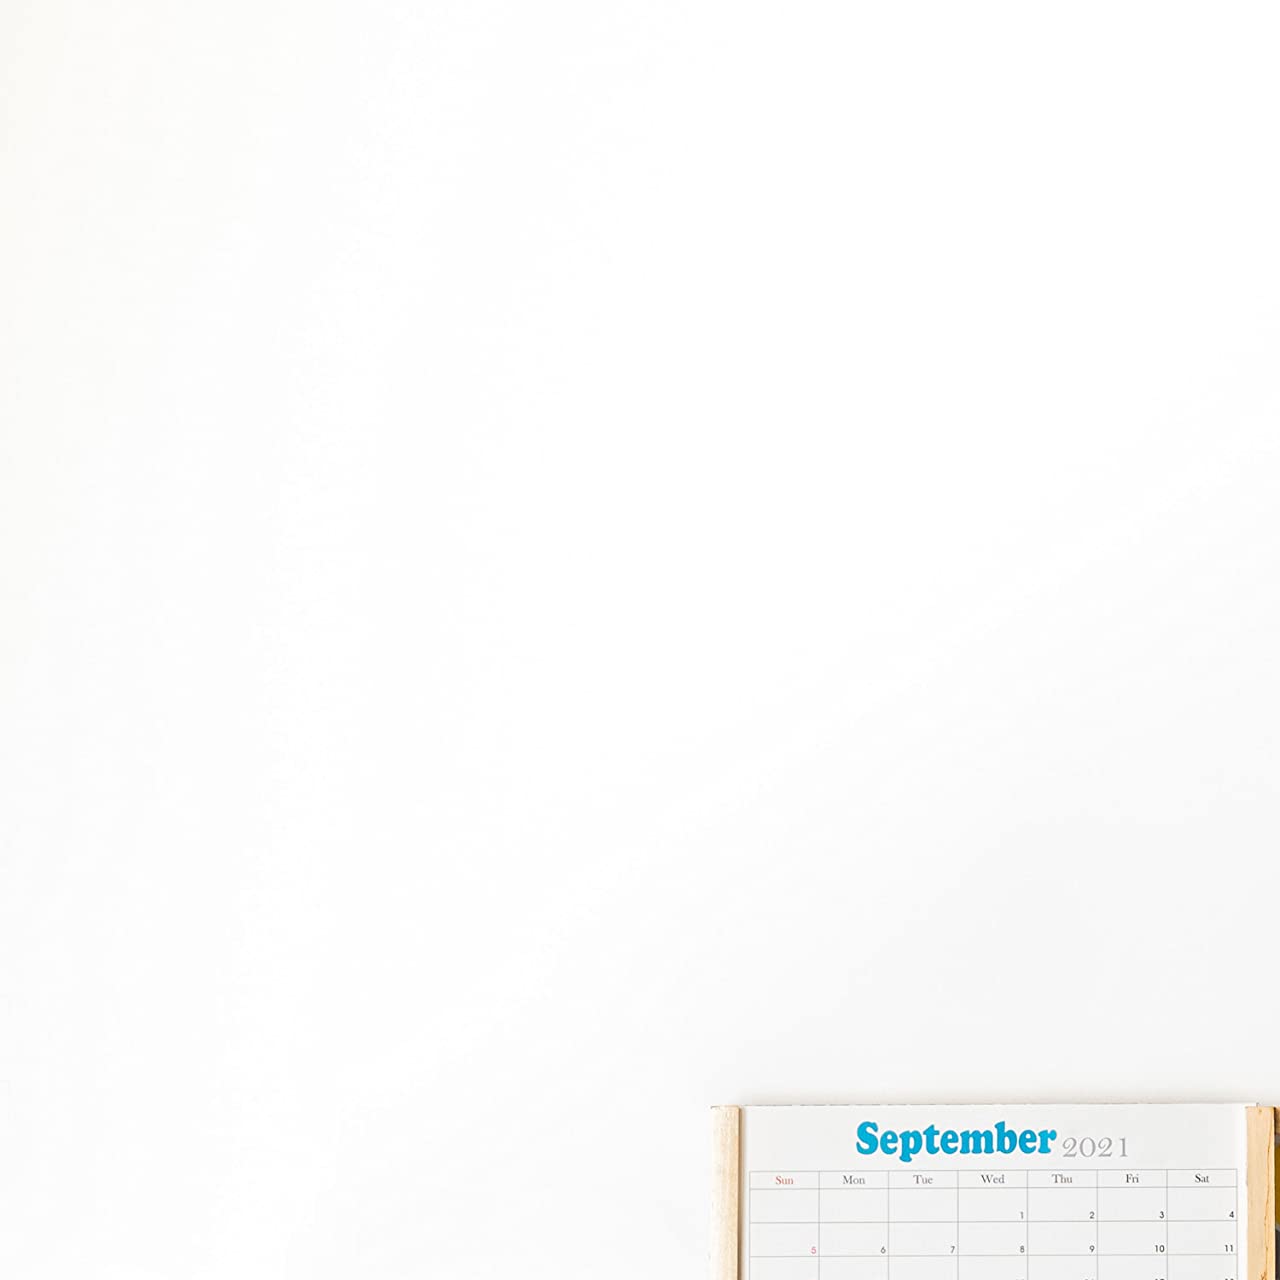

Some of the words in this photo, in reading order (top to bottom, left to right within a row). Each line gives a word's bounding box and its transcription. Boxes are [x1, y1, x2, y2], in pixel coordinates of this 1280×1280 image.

[855, 1120, 1058, 1163] September
[1062, 1136, 1128, 1158] 2021
[775, 1175, 794, 1185] Sun
[842, 1175, 866, 1185] Mon
[912, 1174, 934, 1185] Tue
[980, 1174, 1005, 1184] Wed
[1051, 1173, 1073, 1184] Thu
[1125, 1173, 1139, 1184] Fri
[1194, 1173, 1209, 1183] Sat
[1019, 1211, 1024, 1220] 1
[1089, 1211, 1095, 1220] 2
[1159, 1210, 1165, 1220] 3
[1228, 1210, 1235, 1219] 4
[810, 1246, 817, 1255] 5
[880, 1245, 887, 1255] 6
[950, 1245, 956, 1254] 7
[1019, 1245, 1025, 1254] 8
[1089, 1244, 1095, 1253] 9
[1155, 1244, 1165, 1253] 10
[1224, 1244, 1234, 1252] 11
